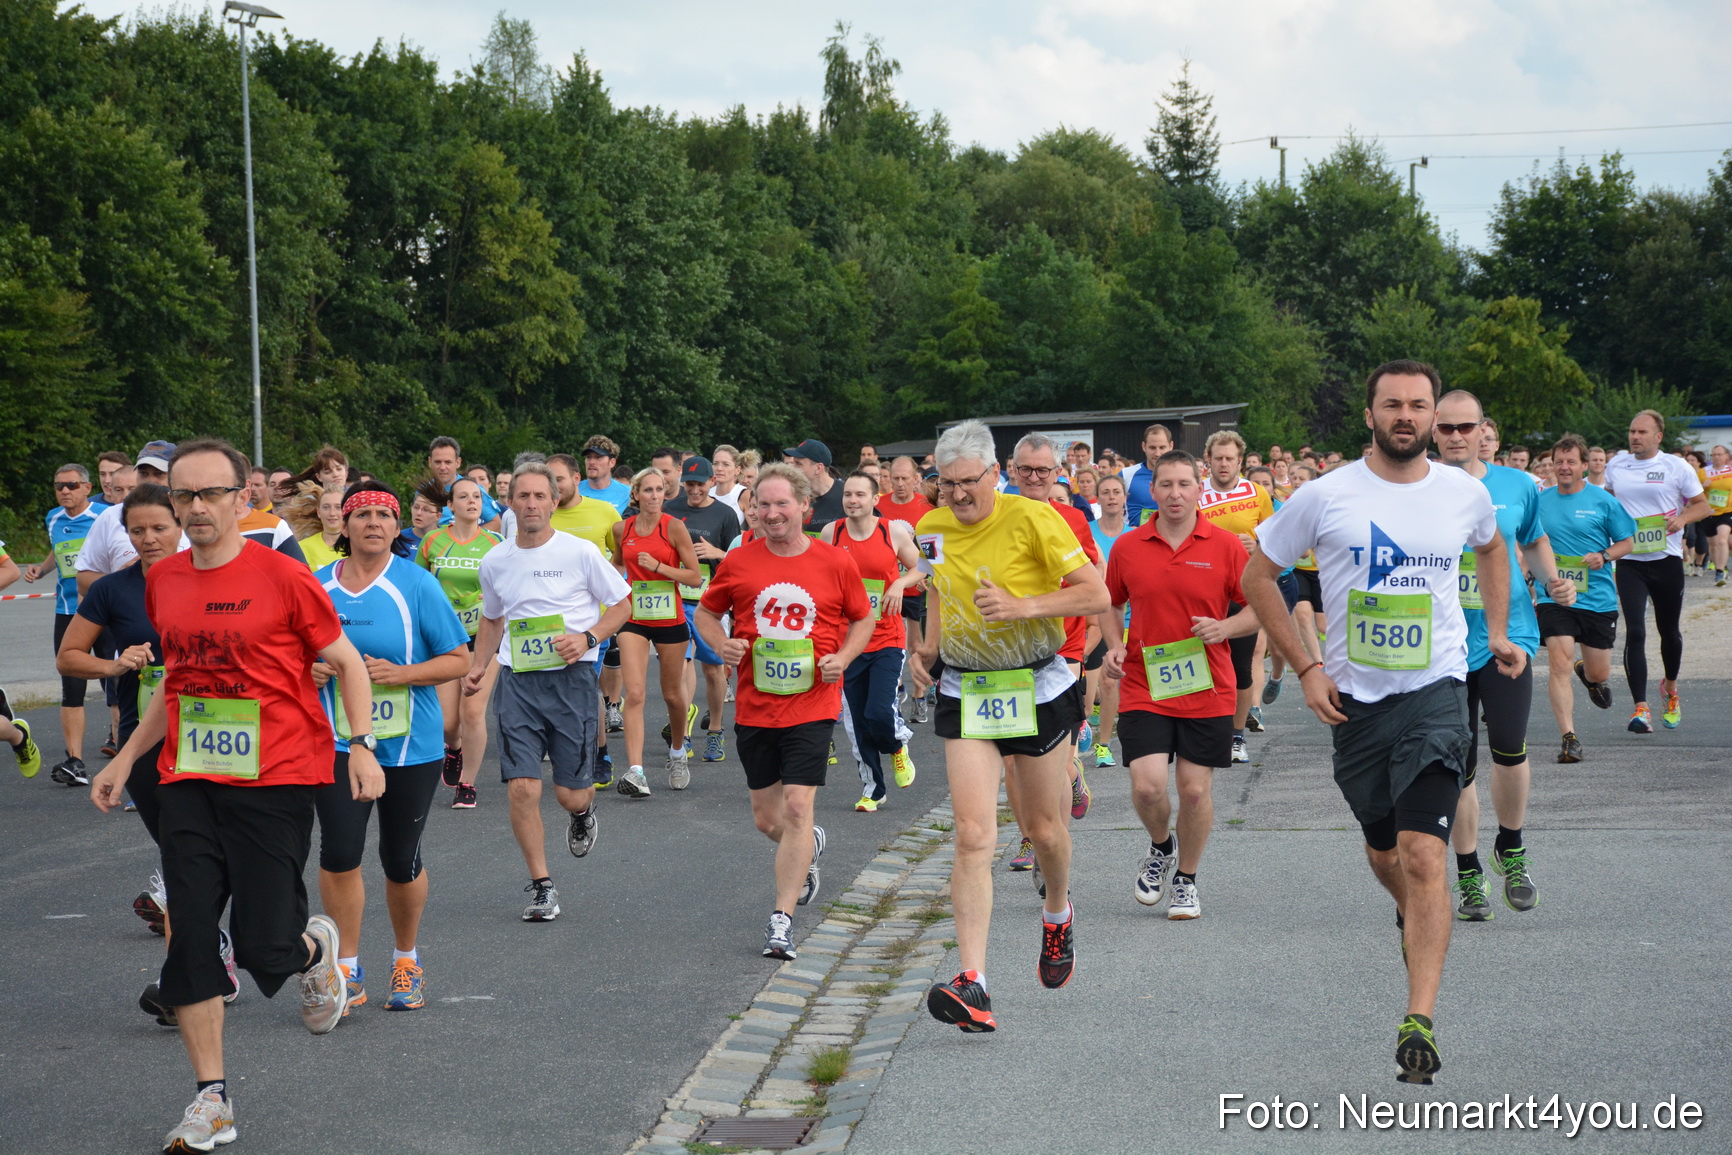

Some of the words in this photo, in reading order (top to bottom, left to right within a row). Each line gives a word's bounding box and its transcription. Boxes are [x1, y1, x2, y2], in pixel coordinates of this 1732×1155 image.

[1230, 500, 1259, 513] BÖGL
[1631, 530, 1663, 544] 1000
[1348, 546, 1365, 566] T
[533, 570, 563, 578] ALBERT
[1380, 573, 1426, 587] Team
[1557, 570, 1584, 583] 064
[205, 602, 236, 611] swn
[636, 595, 670, 609] 1371
[761, 597, 808, 631] 48
[1356, 620, 1423, 649] 1580
[521, 636, 554, 656] 431
[765, 660, 802, 680] 505
[1159, 660, 1195, 683] 511
[183, 683, 211, 695] Alles
[214, 682, 247, 694] läuft
[371, 700, 394, 721] 20
[976, 696, 1018, 720] 481
[187, 728, 251, 757] 1480
